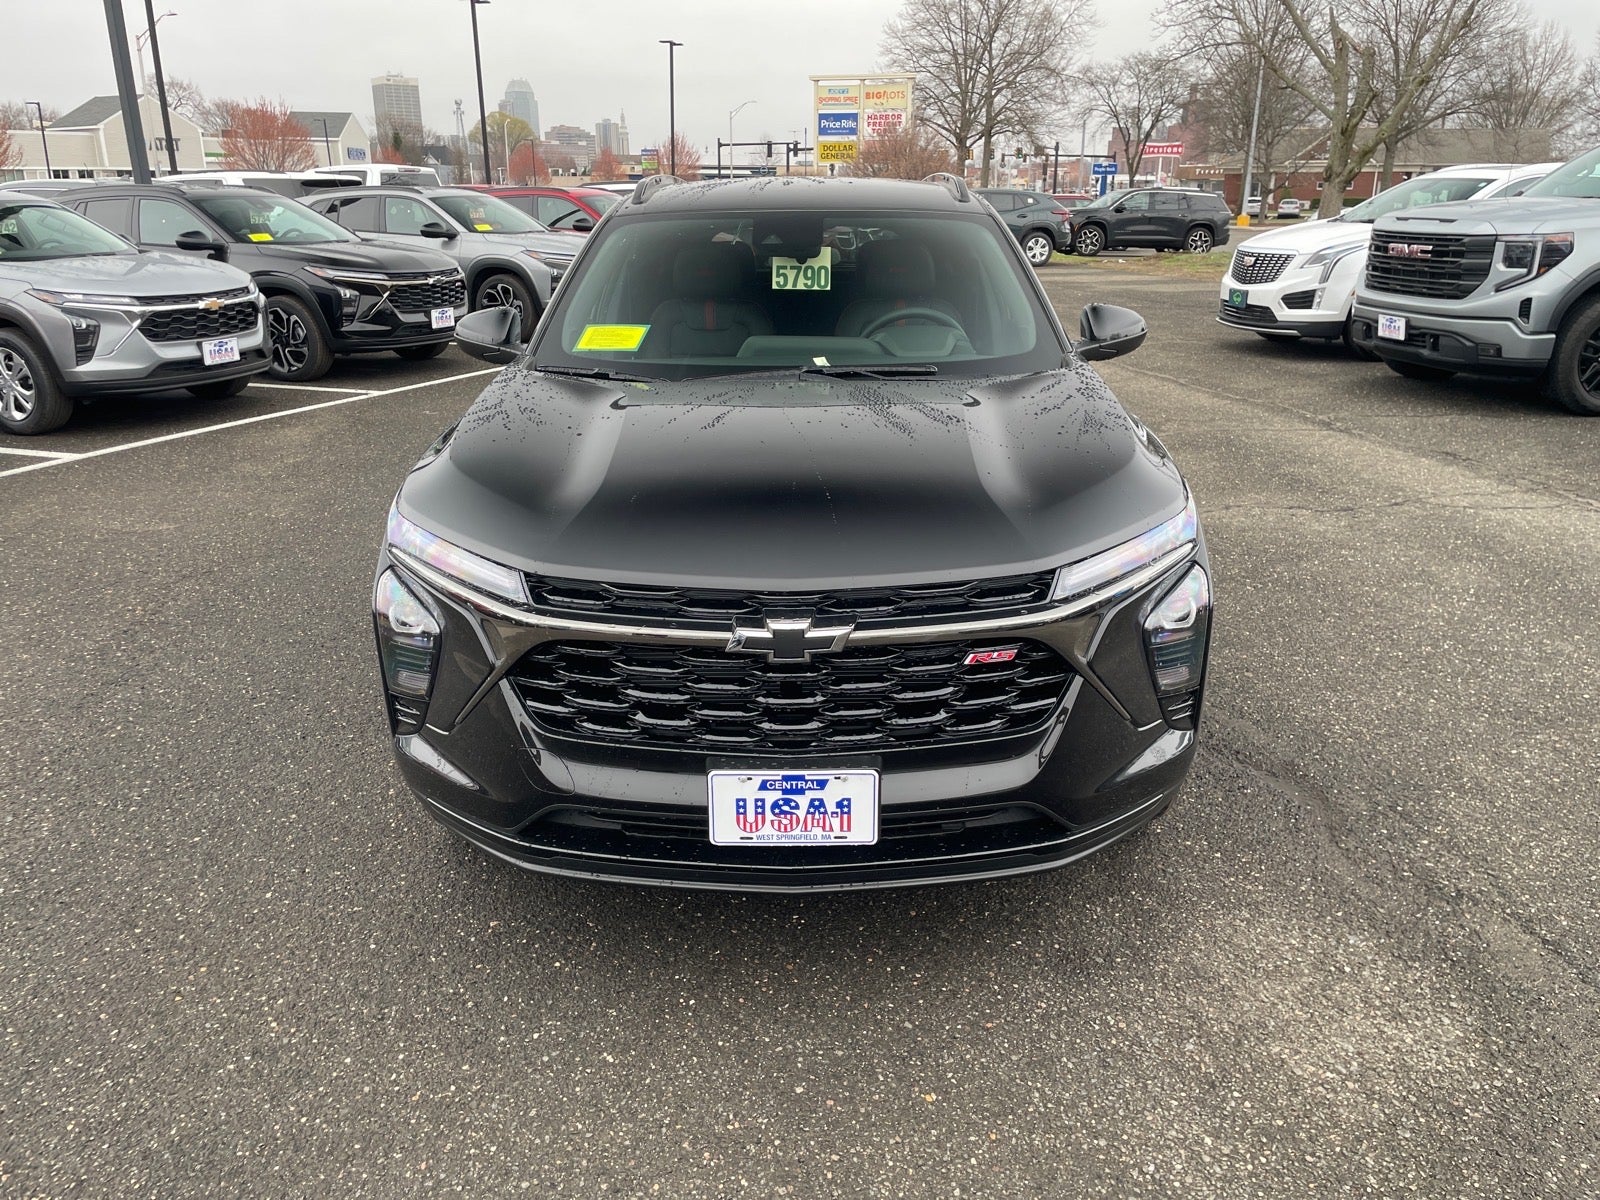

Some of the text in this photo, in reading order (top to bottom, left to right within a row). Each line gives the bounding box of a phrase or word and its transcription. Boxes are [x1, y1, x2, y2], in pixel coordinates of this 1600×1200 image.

[821, 119, 857, 128] Price Rite
[148, 137, 180, 151] ATT
[1388, 243, 1433, 258] GMC
[775, 265, 830, 289] 5790
[963, 648, 1019, 665] RS
[766, 780, 821, 790] CENTRAL
